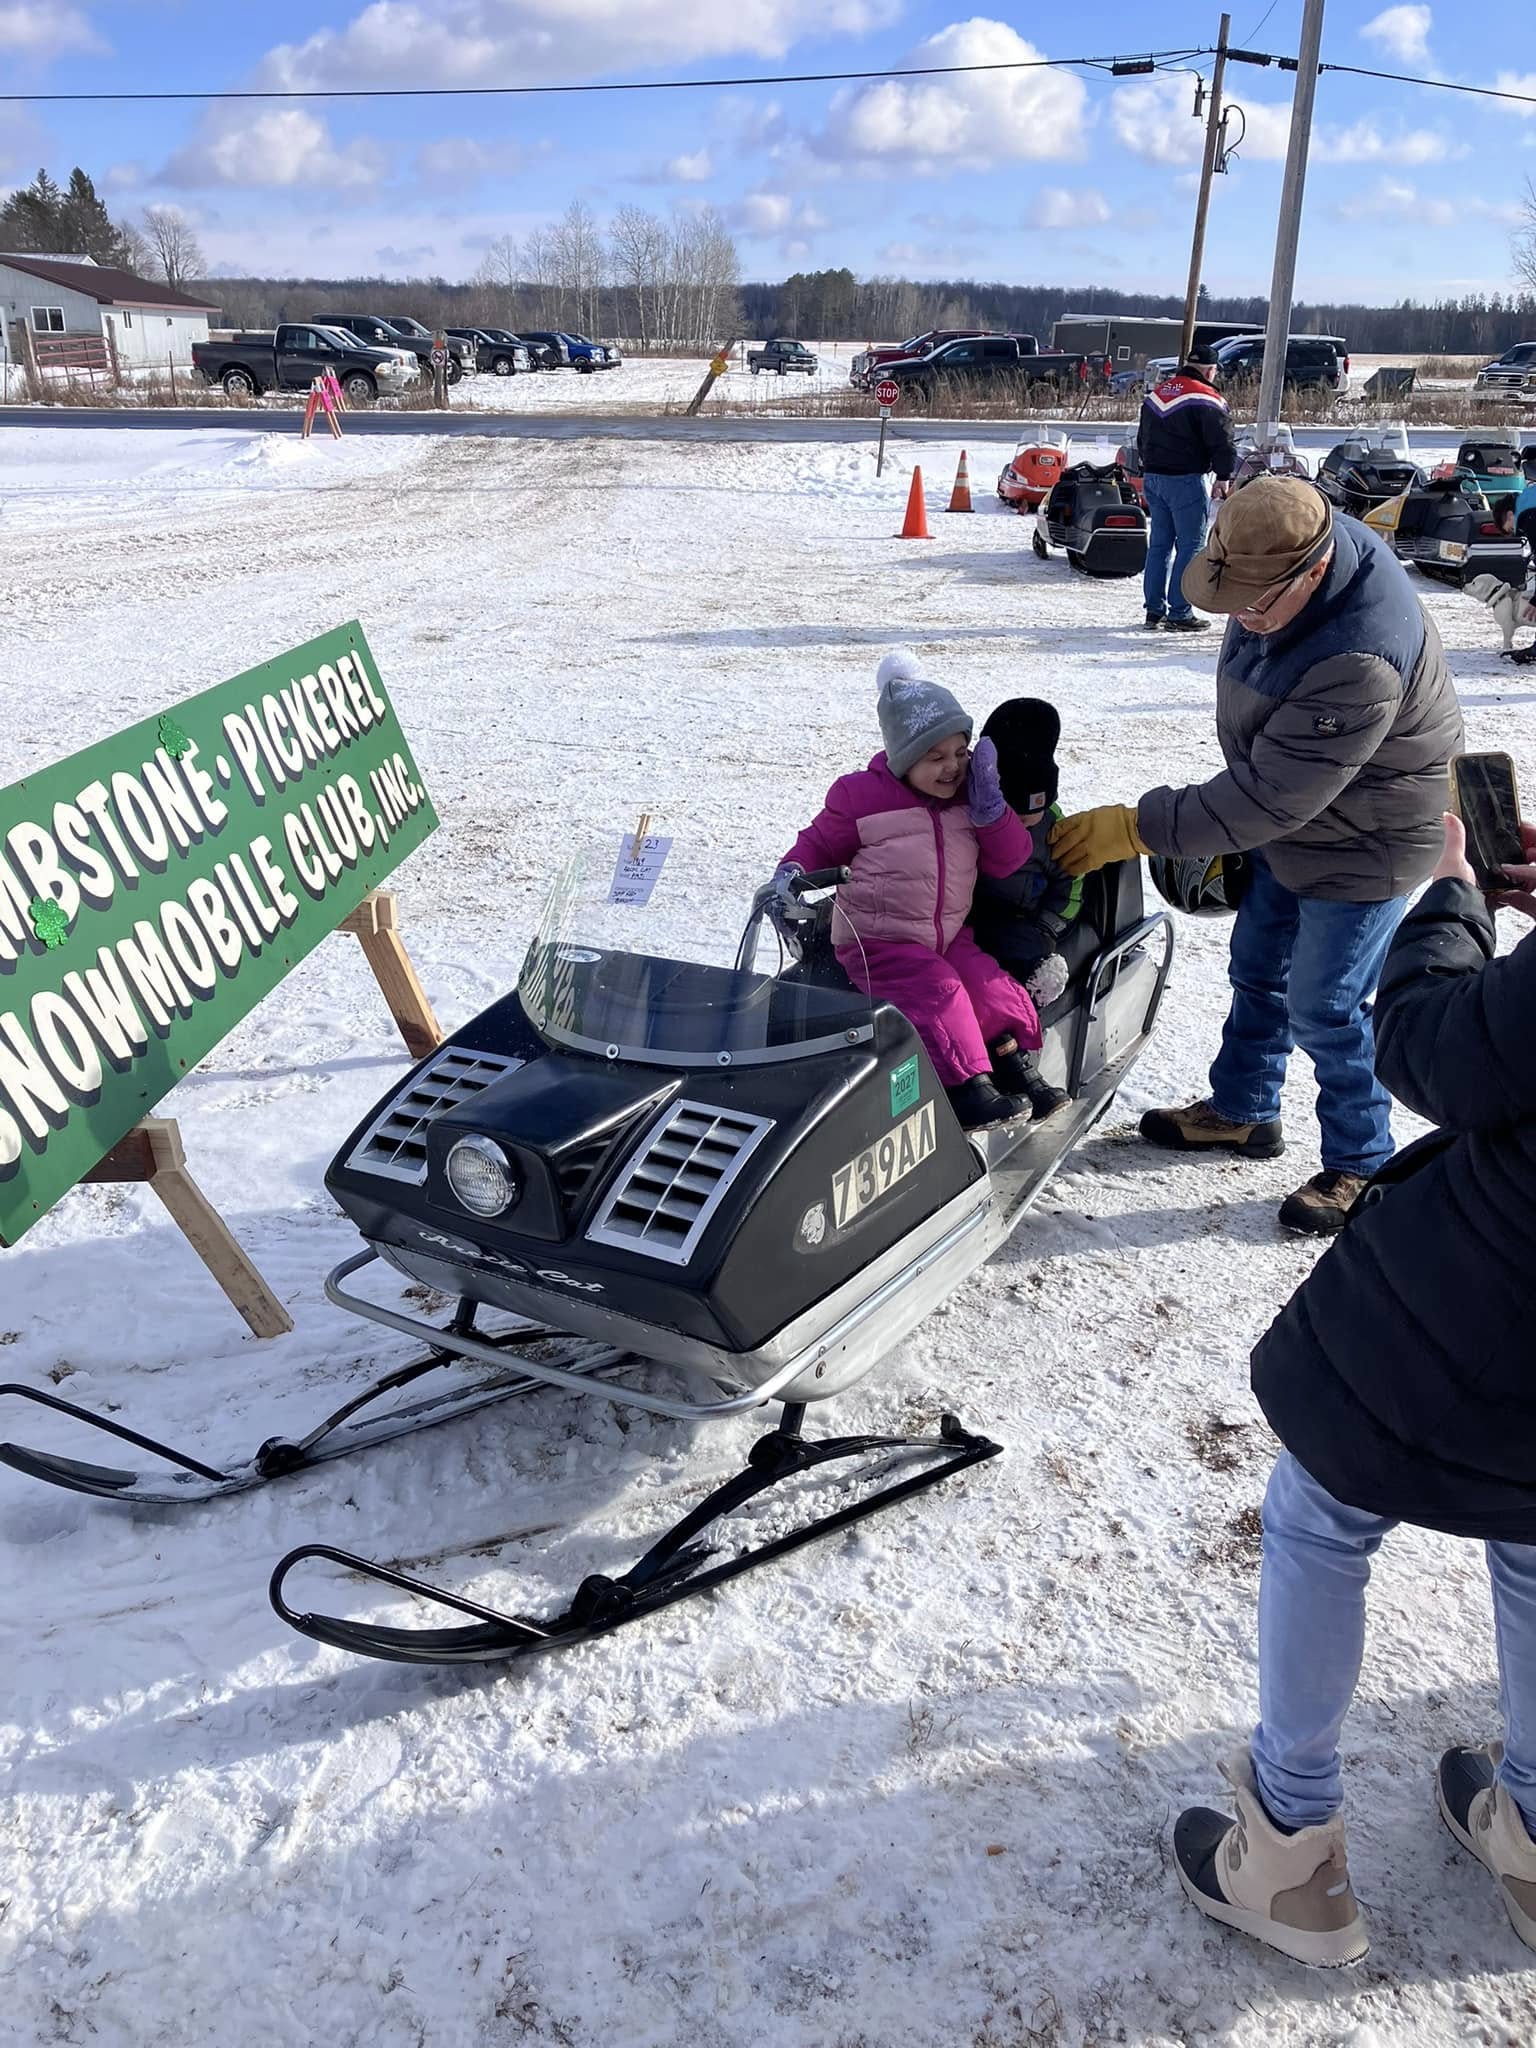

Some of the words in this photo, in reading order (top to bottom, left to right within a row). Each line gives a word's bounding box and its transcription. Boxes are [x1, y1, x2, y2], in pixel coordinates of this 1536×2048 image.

[876, 387, 898, 399] STOP
[223, 649, 386, 797] PICKEREL
[0, 834, 300, 1165] NOWMOBILE
[283, 773, 389, 891] CLUB,
[370, 752, 425, 826] INC.
[895, 1071, 915, 1097] 2027
[536, 1269, 605, 1293] Cat
